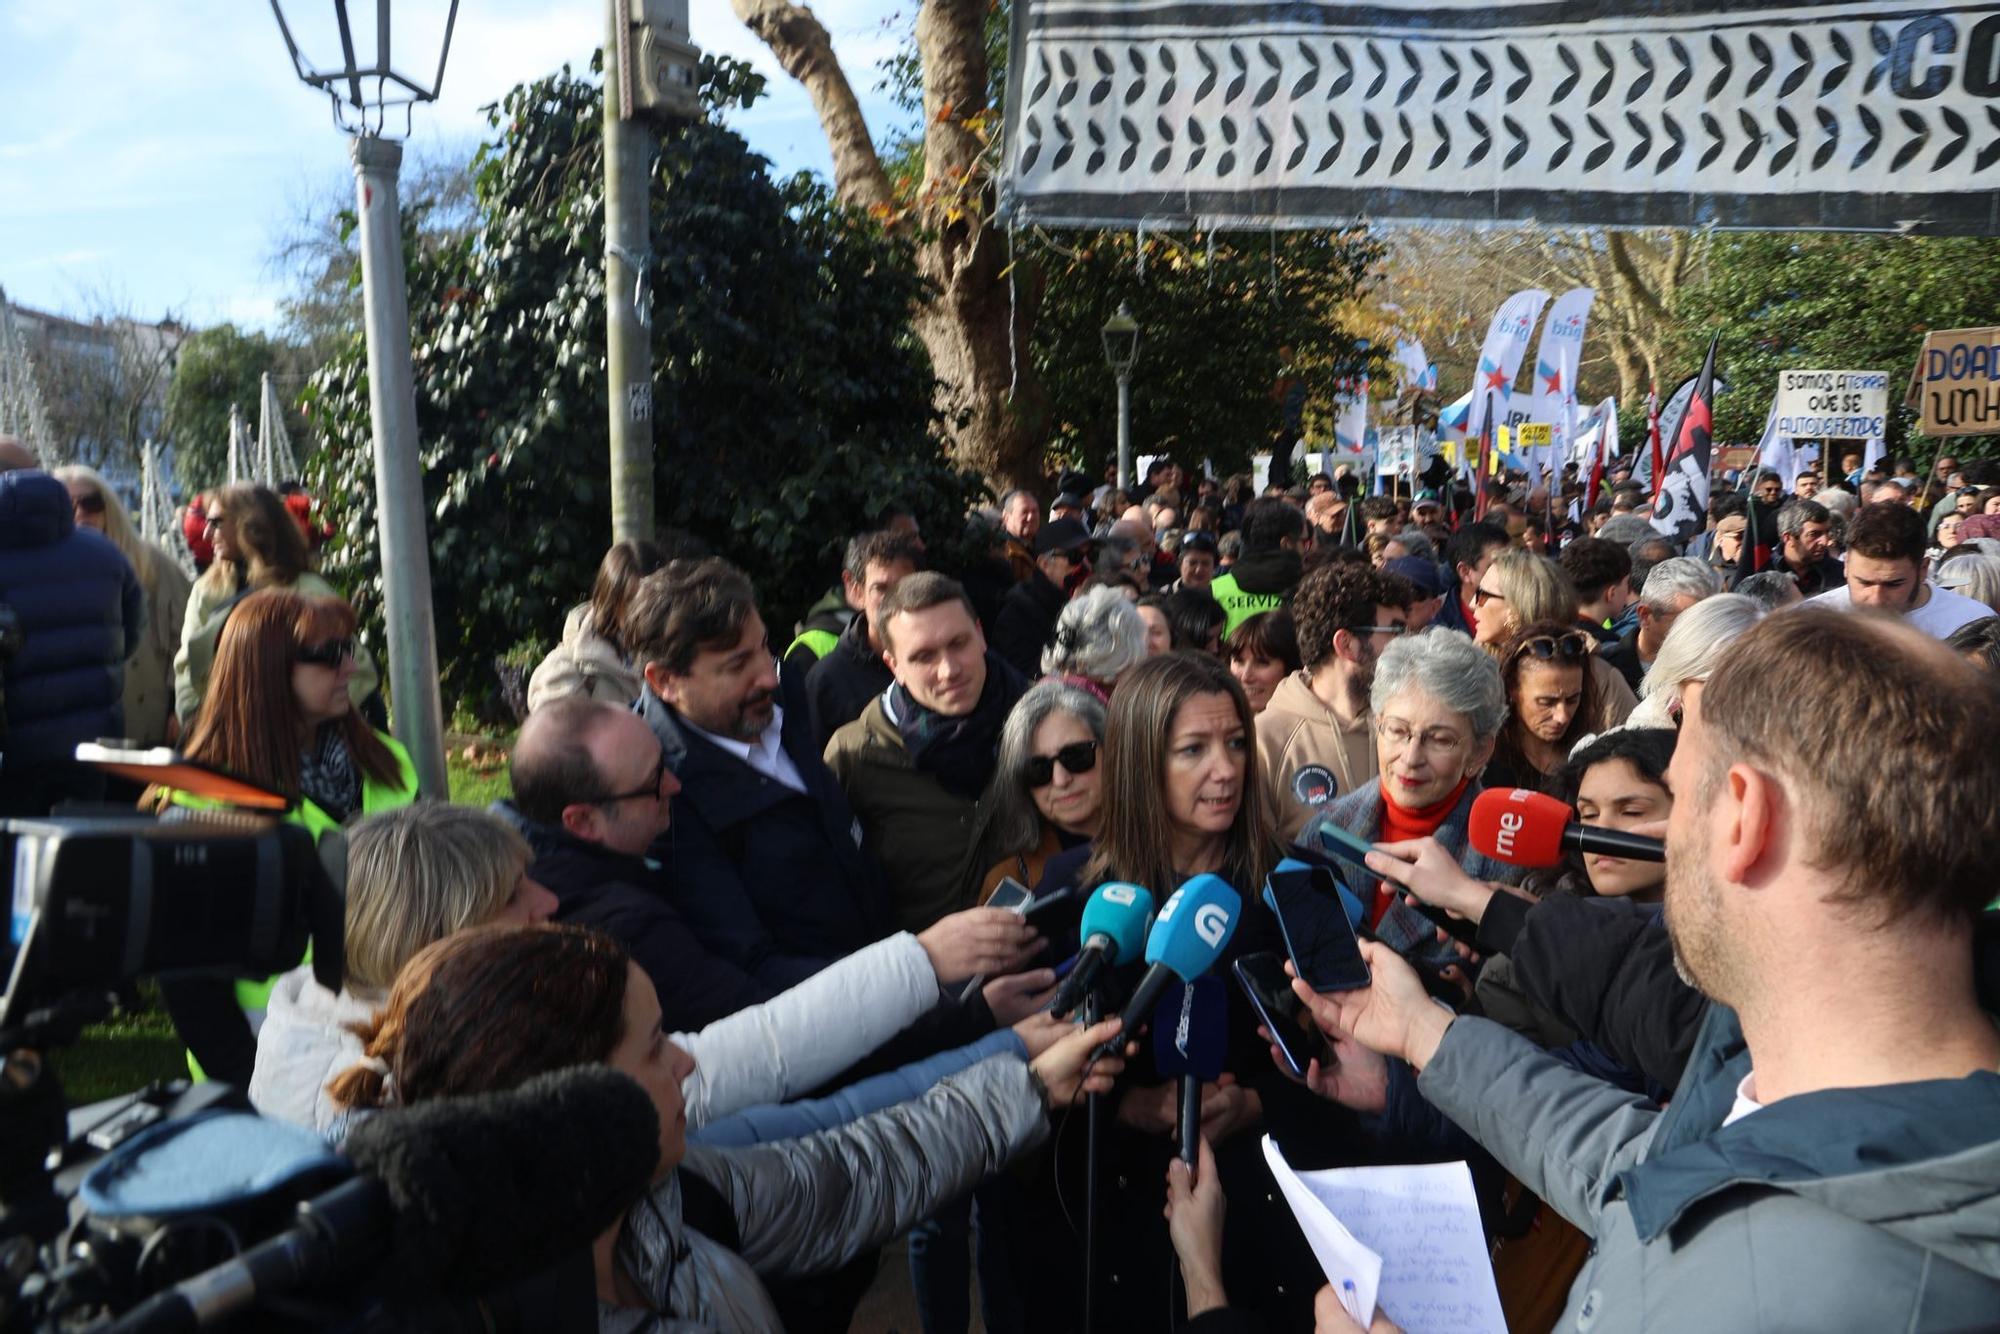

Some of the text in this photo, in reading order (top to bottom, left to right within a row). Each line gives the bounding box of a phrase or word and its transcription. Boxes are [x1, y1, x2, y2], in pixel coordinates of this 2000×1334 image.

[1808, 393, 1862, 413] QUE SE
[1779, 416, 1885, 437] AUTODEFENDE
[1496, 812, 1523, 857] rne
